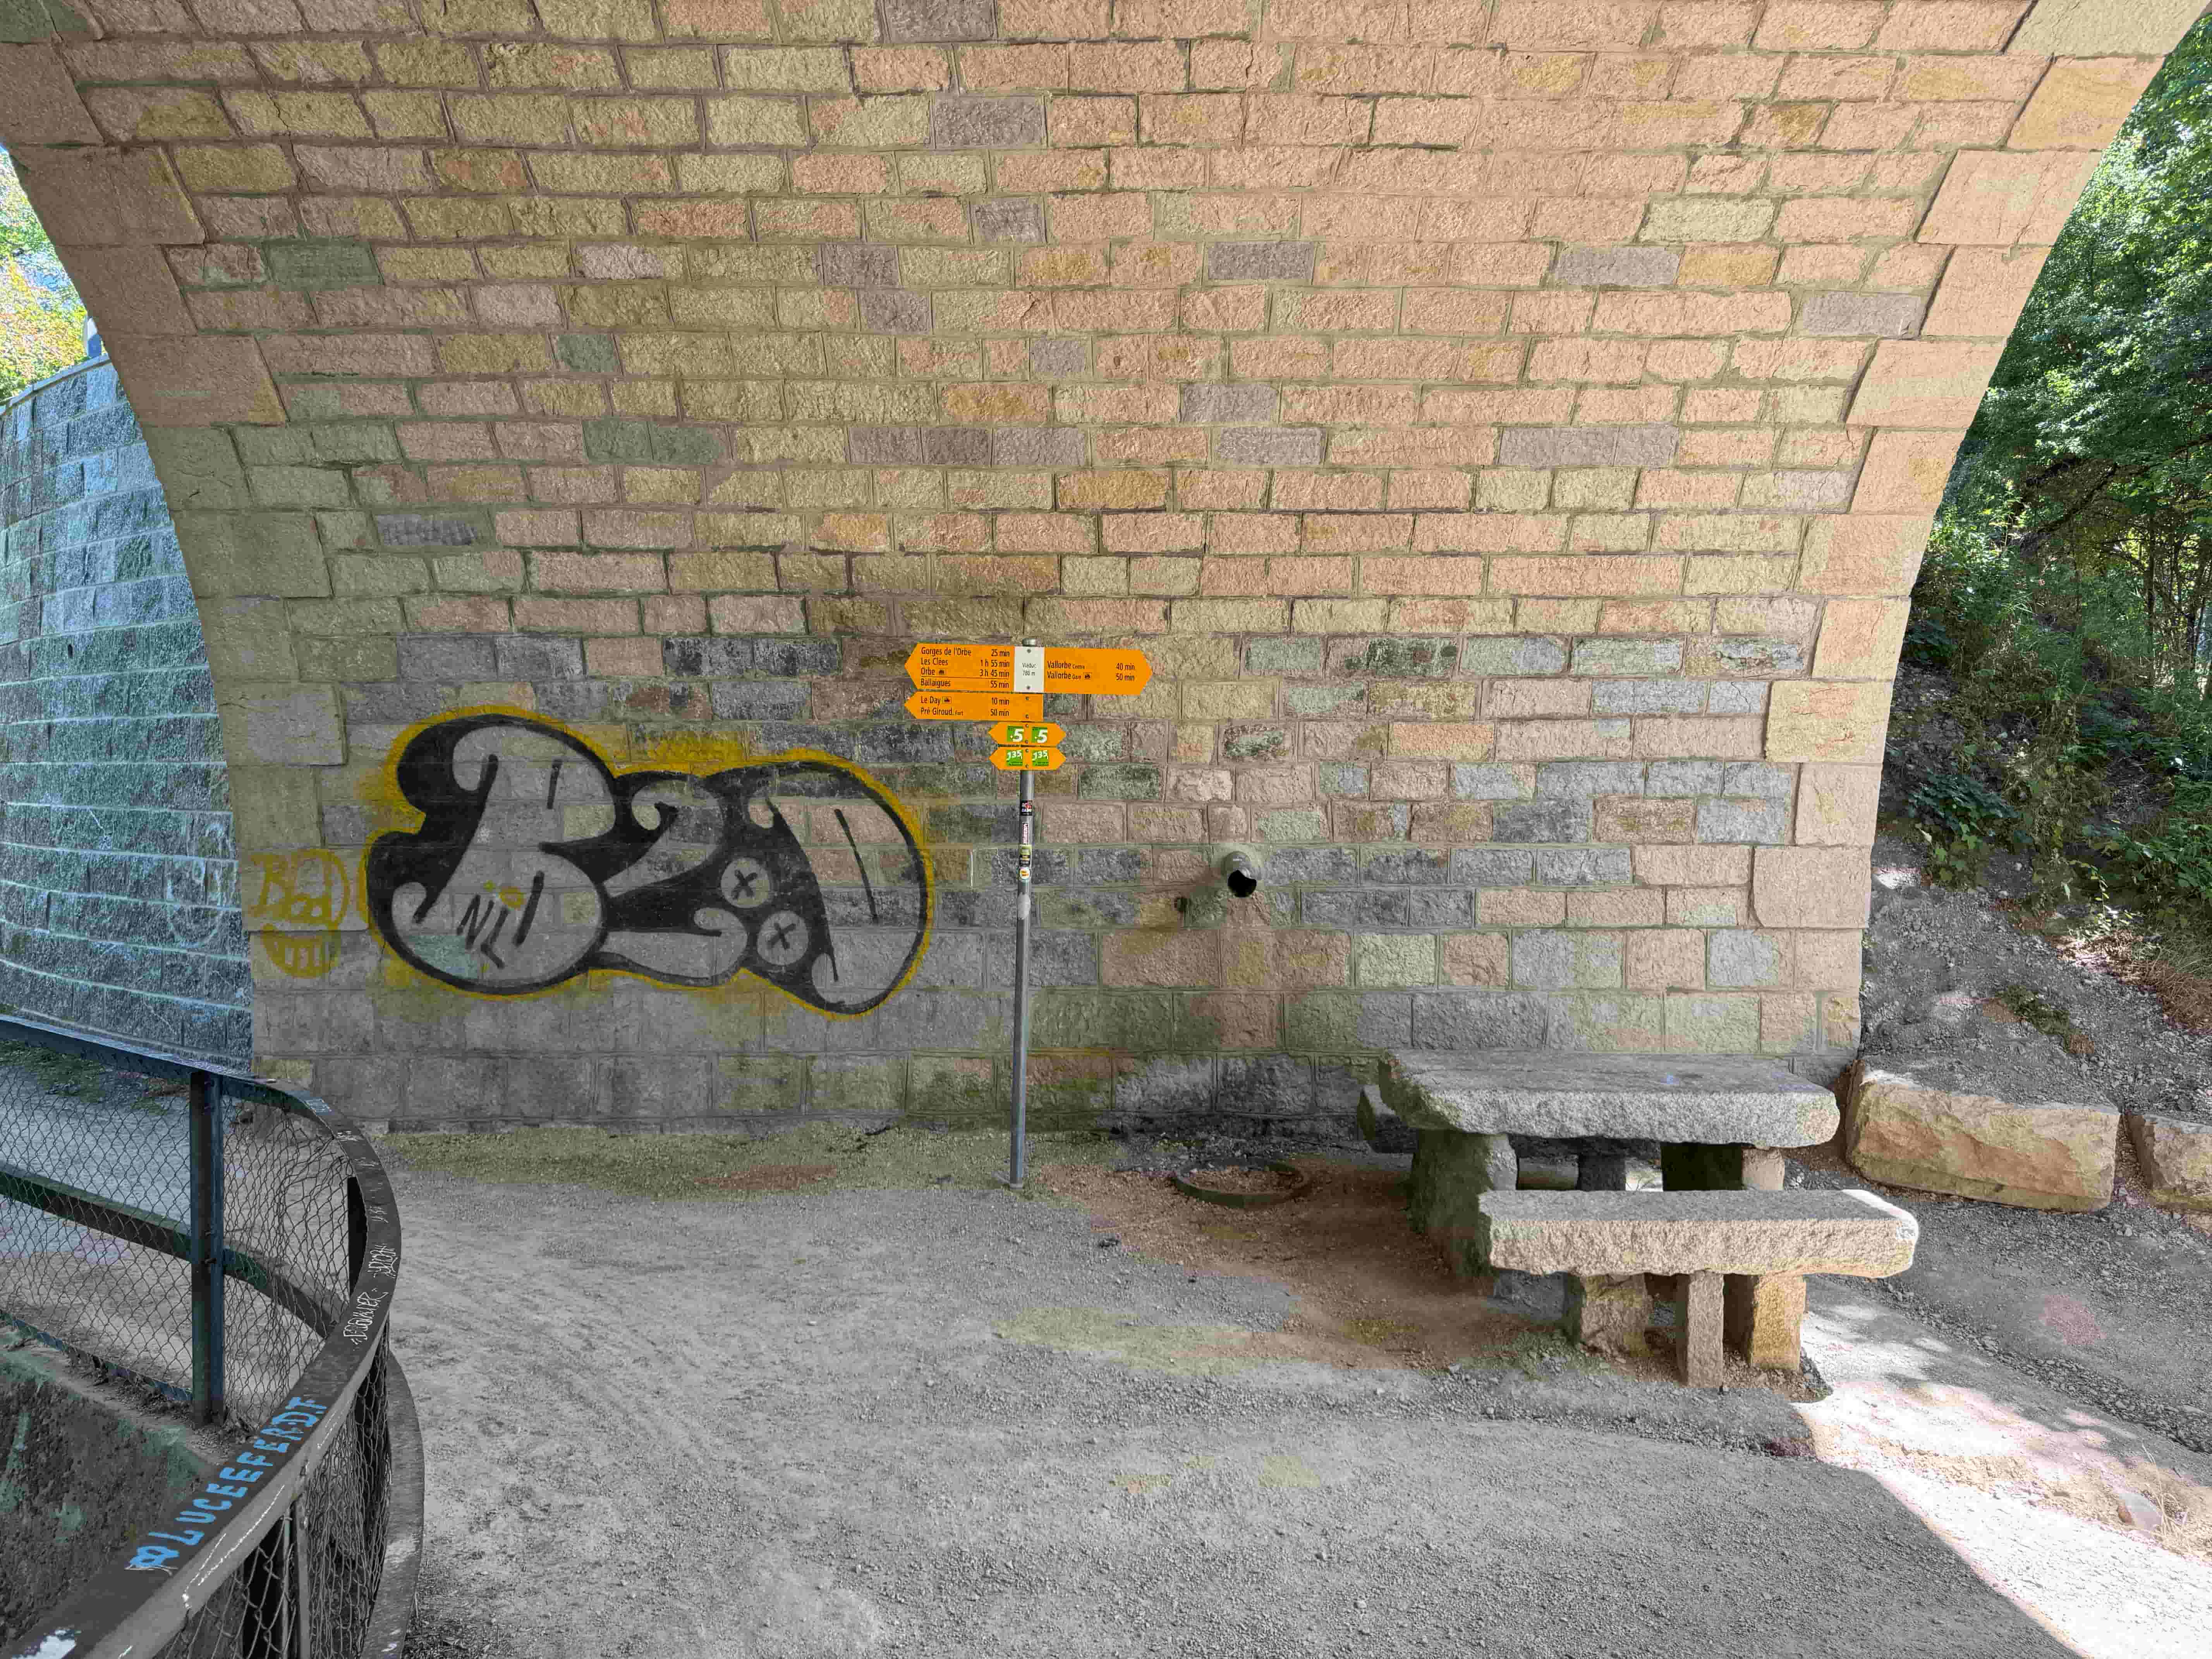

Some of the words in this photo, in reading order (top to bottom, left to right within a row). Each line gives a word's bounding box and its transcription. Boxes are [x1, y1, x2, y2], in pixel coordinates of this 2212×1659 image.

[920, 647, 942, 657] Gorges
[954, 647, 971, 656] l'Orbe
[1000, 649, 1010, 657] min
[1047, 660, 1071, 670] Vallorbe
[921, 667, 935, 675] Orbe
[991, 669, 998, 677] 45
[1047, 670, 1071, 679] Vallorbe
[921, 678, 951, 688] Ballaigues
[929, 696, 941, 706] Day
[921, 707, 930, 716] Pré
[1013, 728, 1024, 742] 5
[1037, 729, 1048, 744] 5
